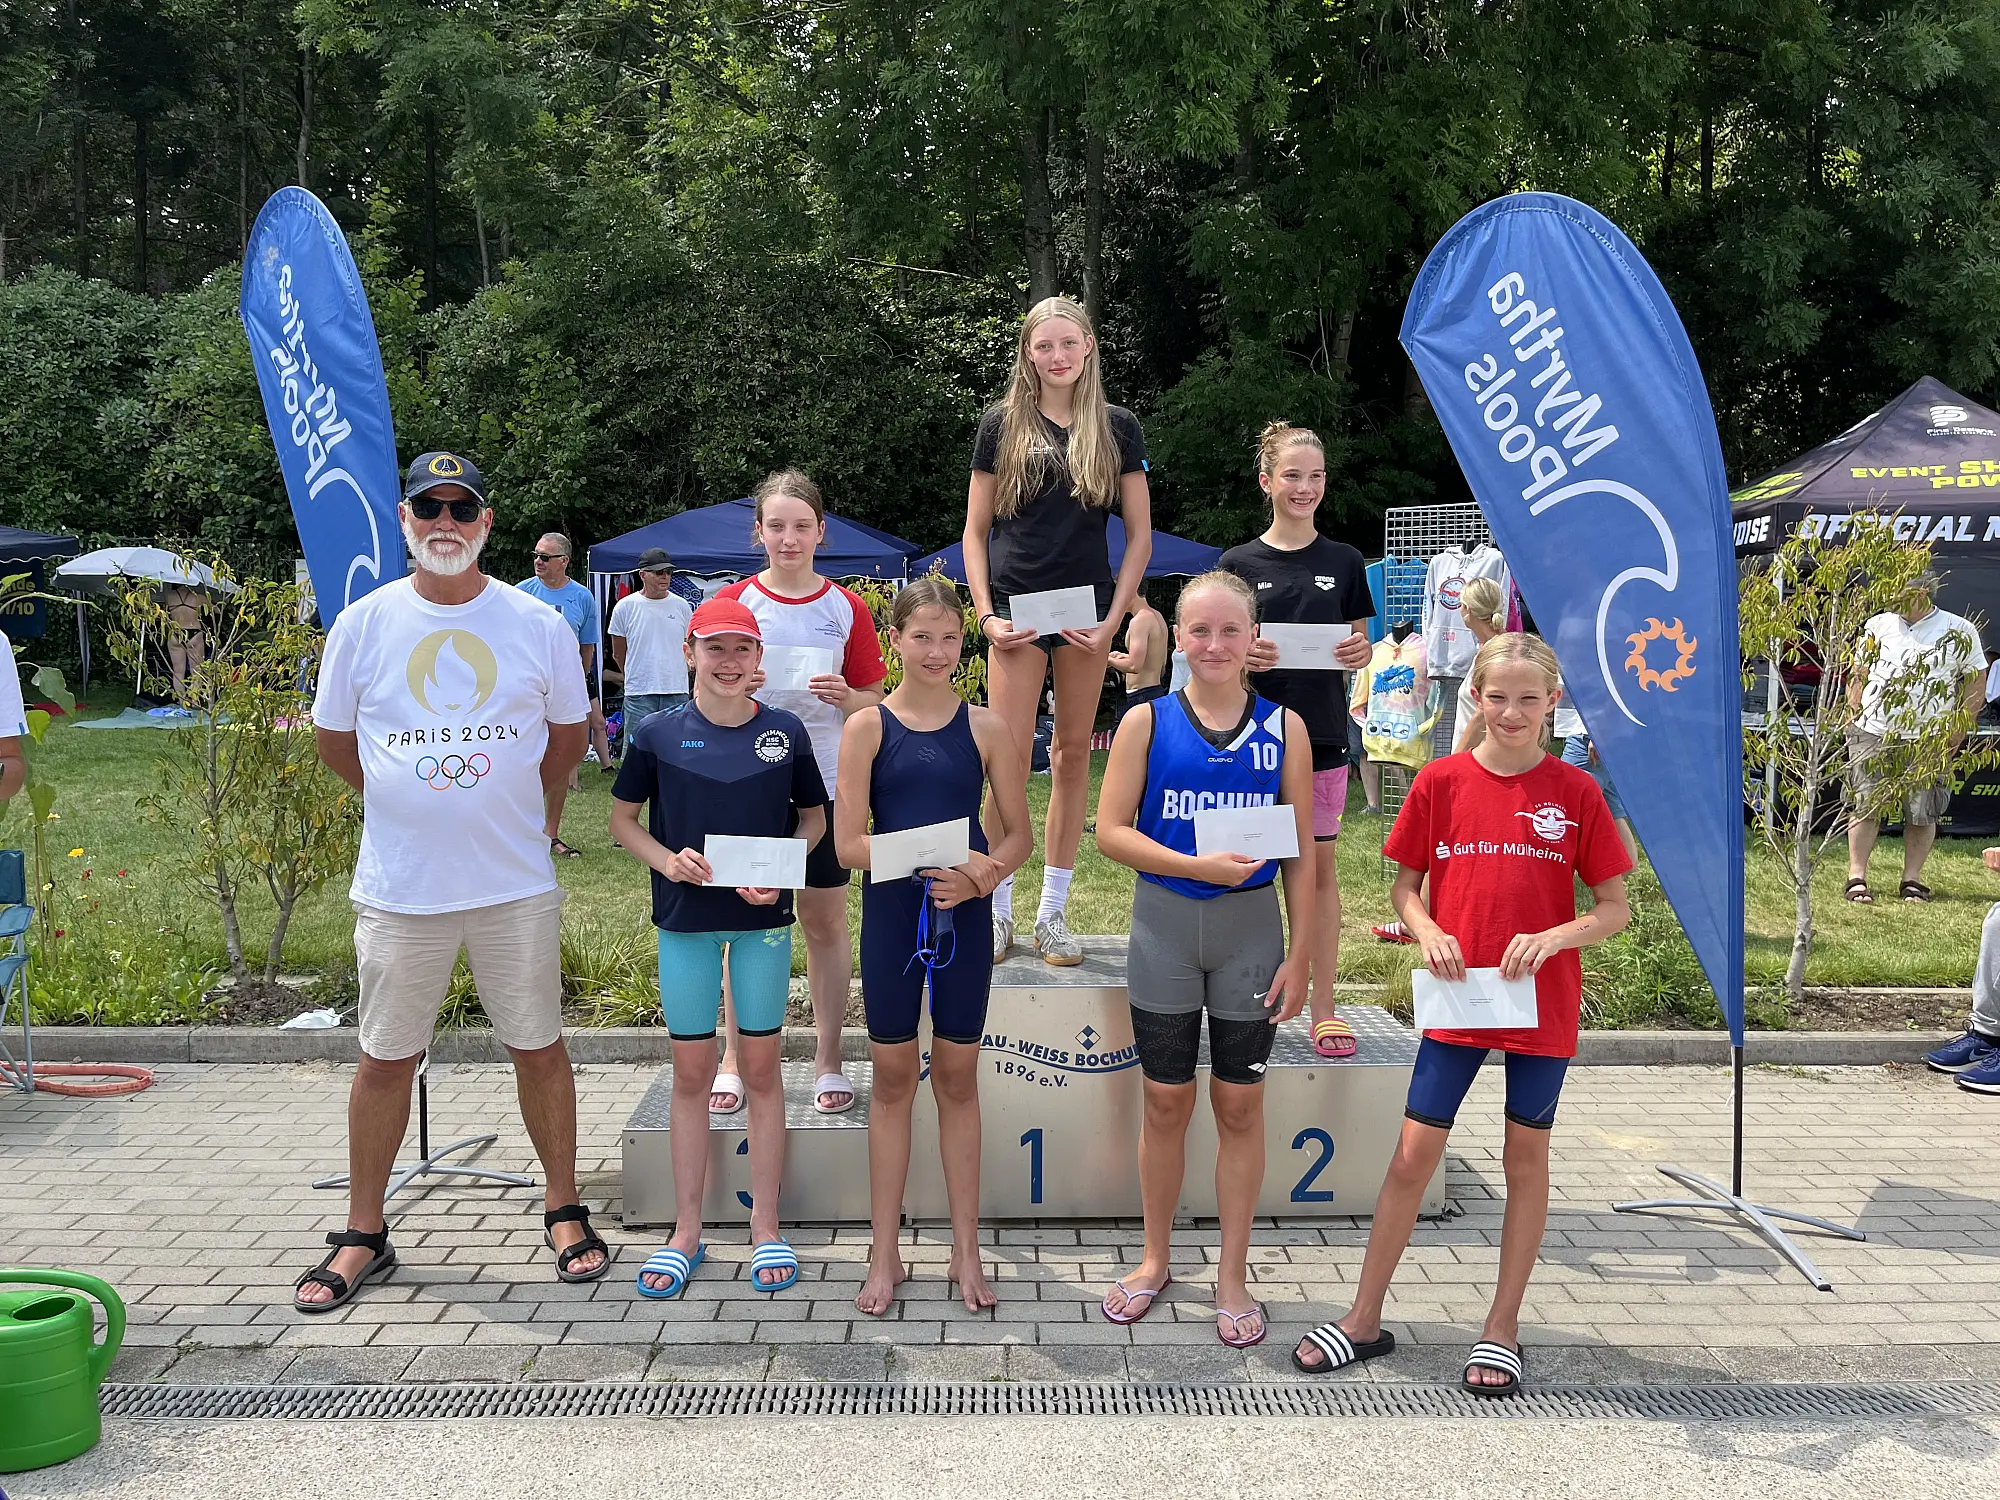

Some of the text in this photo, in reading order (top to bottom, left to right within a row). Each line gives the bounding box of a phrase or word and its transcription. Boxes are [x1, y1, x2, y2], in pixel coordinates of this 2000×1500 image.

[1850, 460, 2000, 478] EVENT SH
[1929, 474, 2000, 489] POW
[462, 724, 519, 742] 2024
[680, 740, 705, 748] JAKO
[1249, 742, 1278, 771] 10
[1453, 841, 1567, 864] Gut für Mülheim.
[994, 1061, 1068, 1087] 1896 e.V.
[1020, 1128, 1043, 1204] 1
[1290, 1127, 1335, 1202] 2
